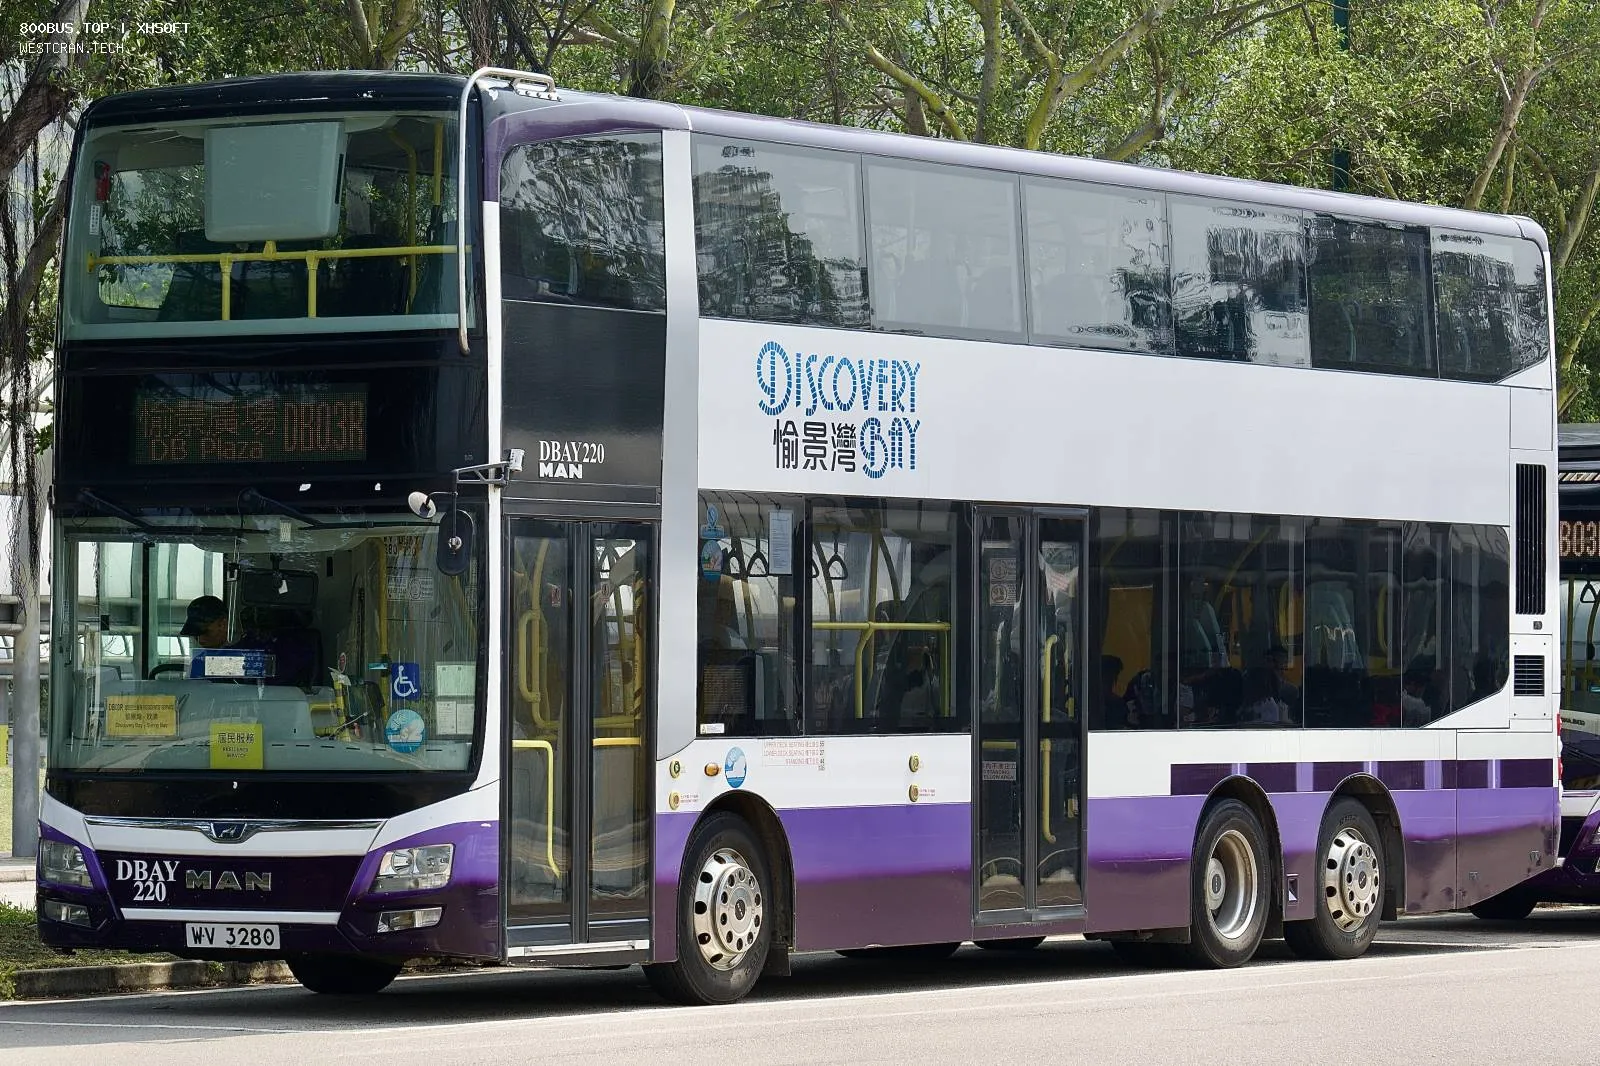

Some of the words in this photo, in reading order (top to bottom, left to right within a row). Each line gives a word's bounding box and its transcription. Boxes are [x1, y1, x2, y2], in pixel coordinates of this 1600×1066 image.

[773, 418, 857, 473] 愉景灣
[859, 416, 921, 479] BAY
[539, 462, 583, 479] MAN
[1559, 520, 1600, 557] B03
[116, 859, 181, 882] DBAY
[185, 869, 272, 892] MAN
[133, 880, 167, 902] 220
[191, 926, 216, 945] WV
[226, 927, 275, 947] 3280
